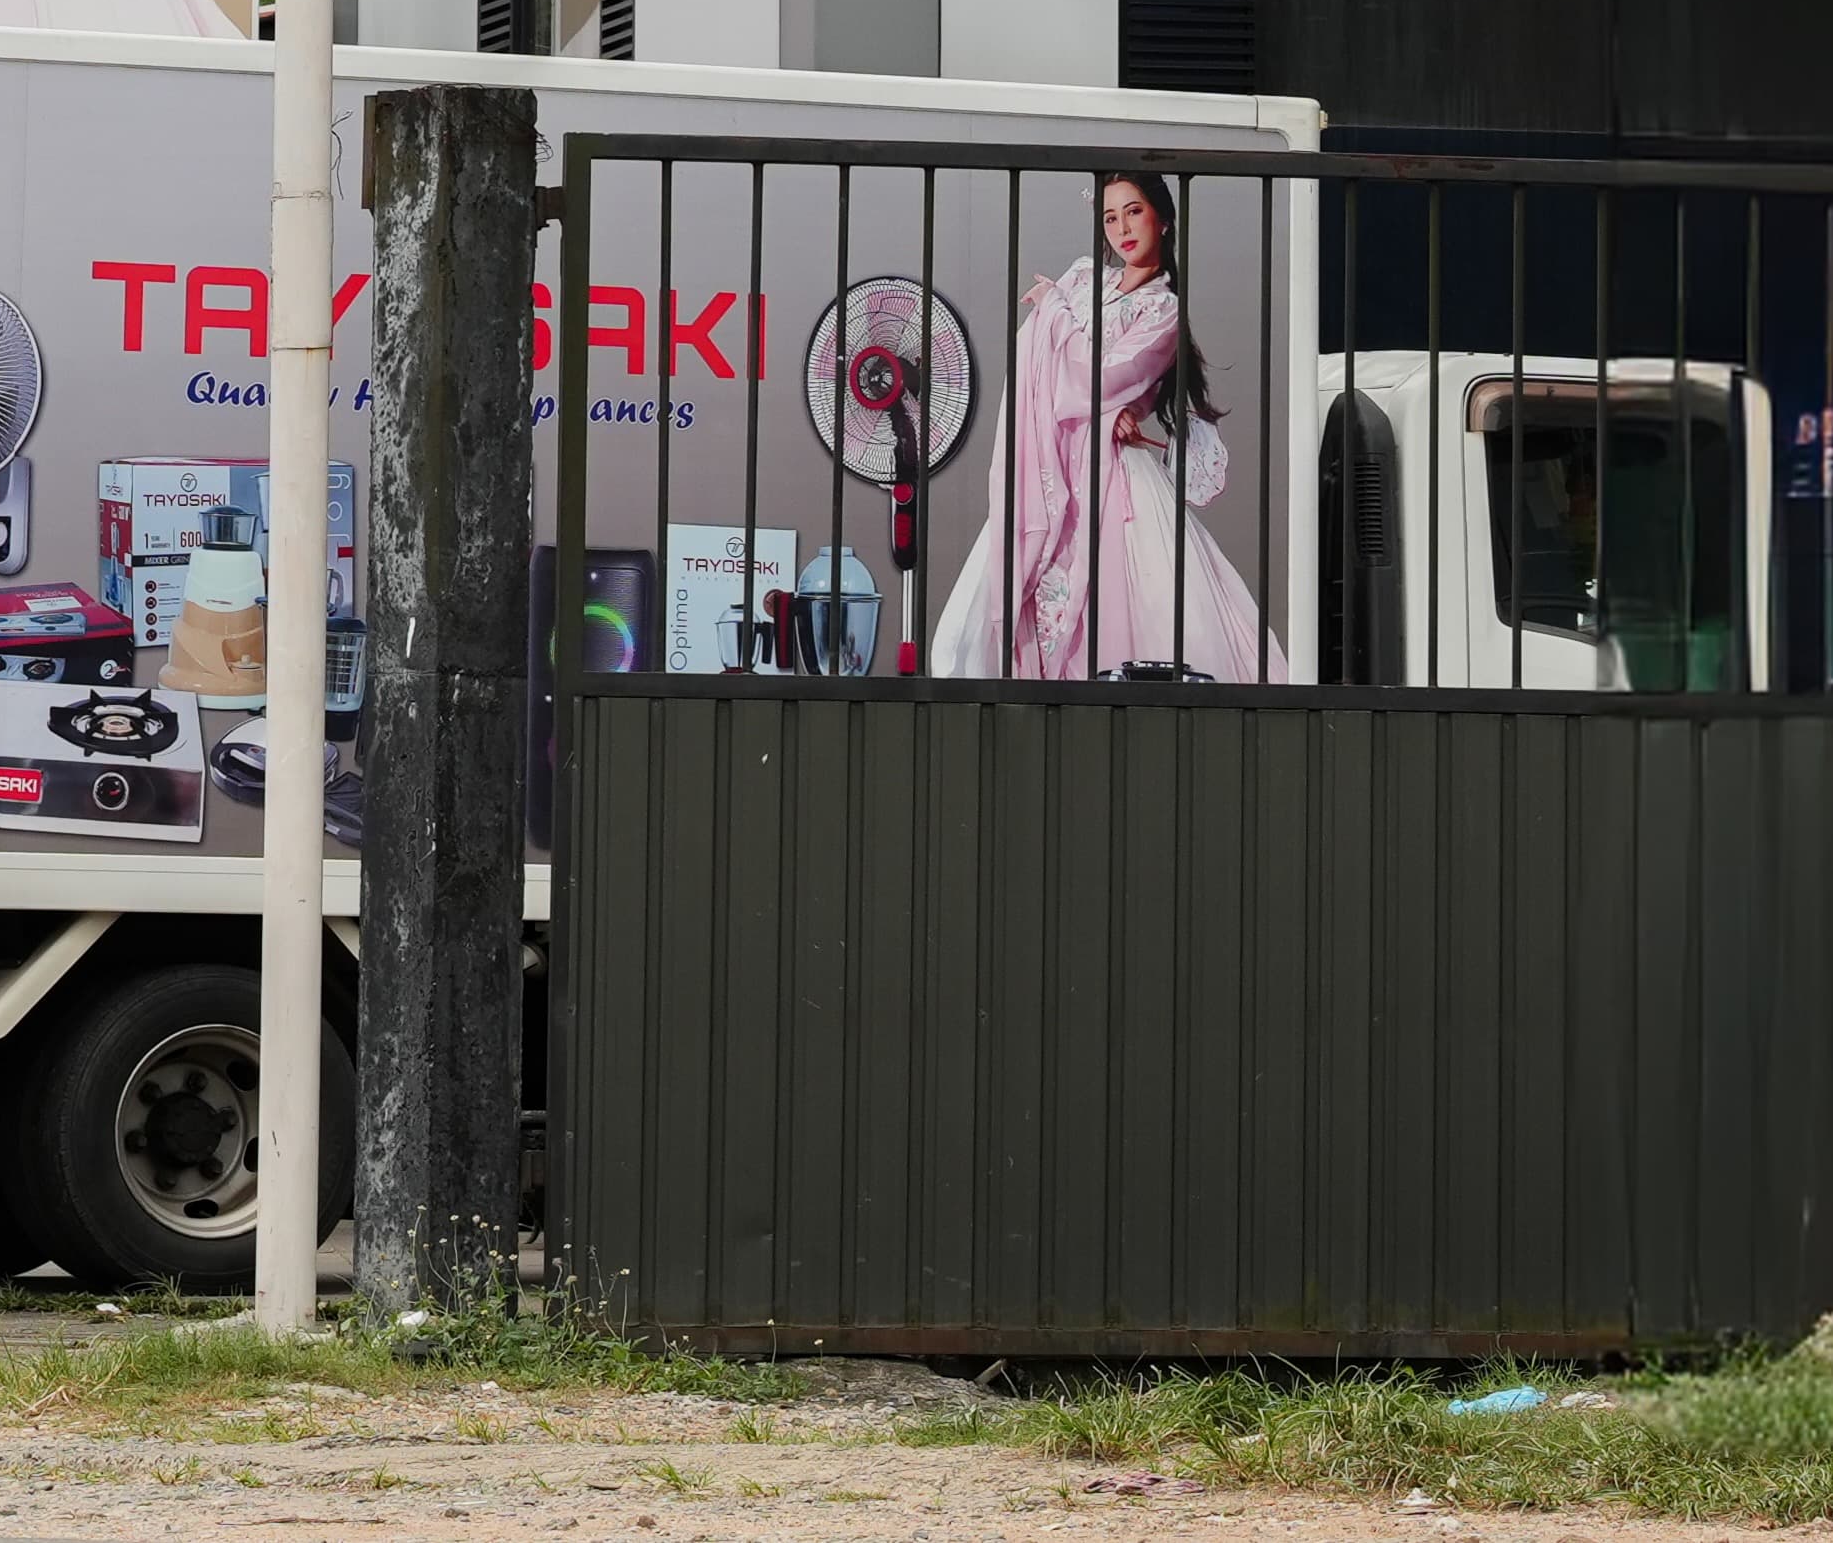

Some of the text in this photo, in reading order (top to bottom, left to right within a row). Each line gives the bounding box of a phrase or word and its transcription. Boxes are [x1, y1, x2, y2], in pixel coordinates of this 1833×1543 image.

[143, 494, 226, 507] TAYOSAKI
[670, 589, 692, 671] Optima
[104, 663, 113, 677] 2
